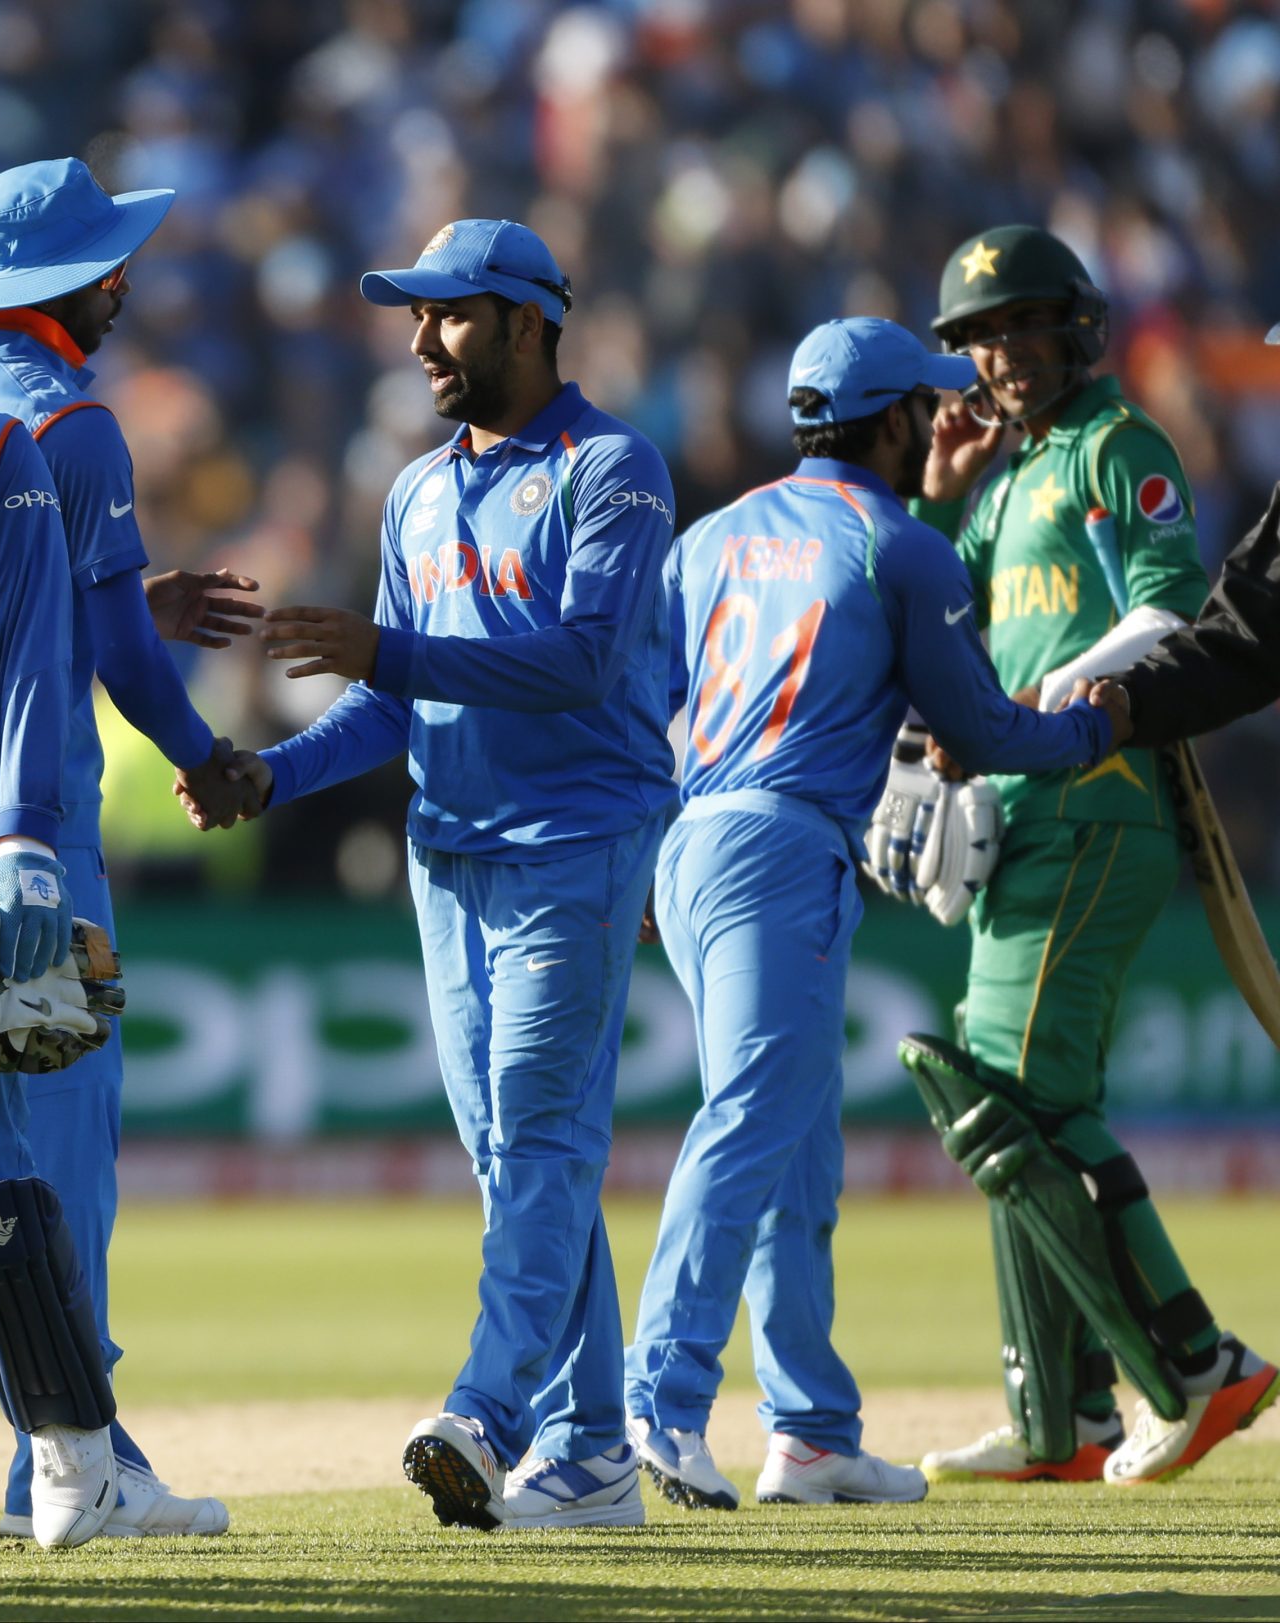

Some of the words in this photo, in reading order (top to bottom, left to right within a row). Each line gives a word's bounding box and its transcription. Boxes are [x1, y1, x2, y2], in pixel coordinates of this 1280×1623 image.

[4, 489, 61, 512] oppo
[609, 491, 673, 525] oppo
[407, 540, 535, 606] INDIA
[716, 534, 823, 582] KEDAR
[988, 564, 1079, 625] STAN
[690, 593, 827, 766] 81
